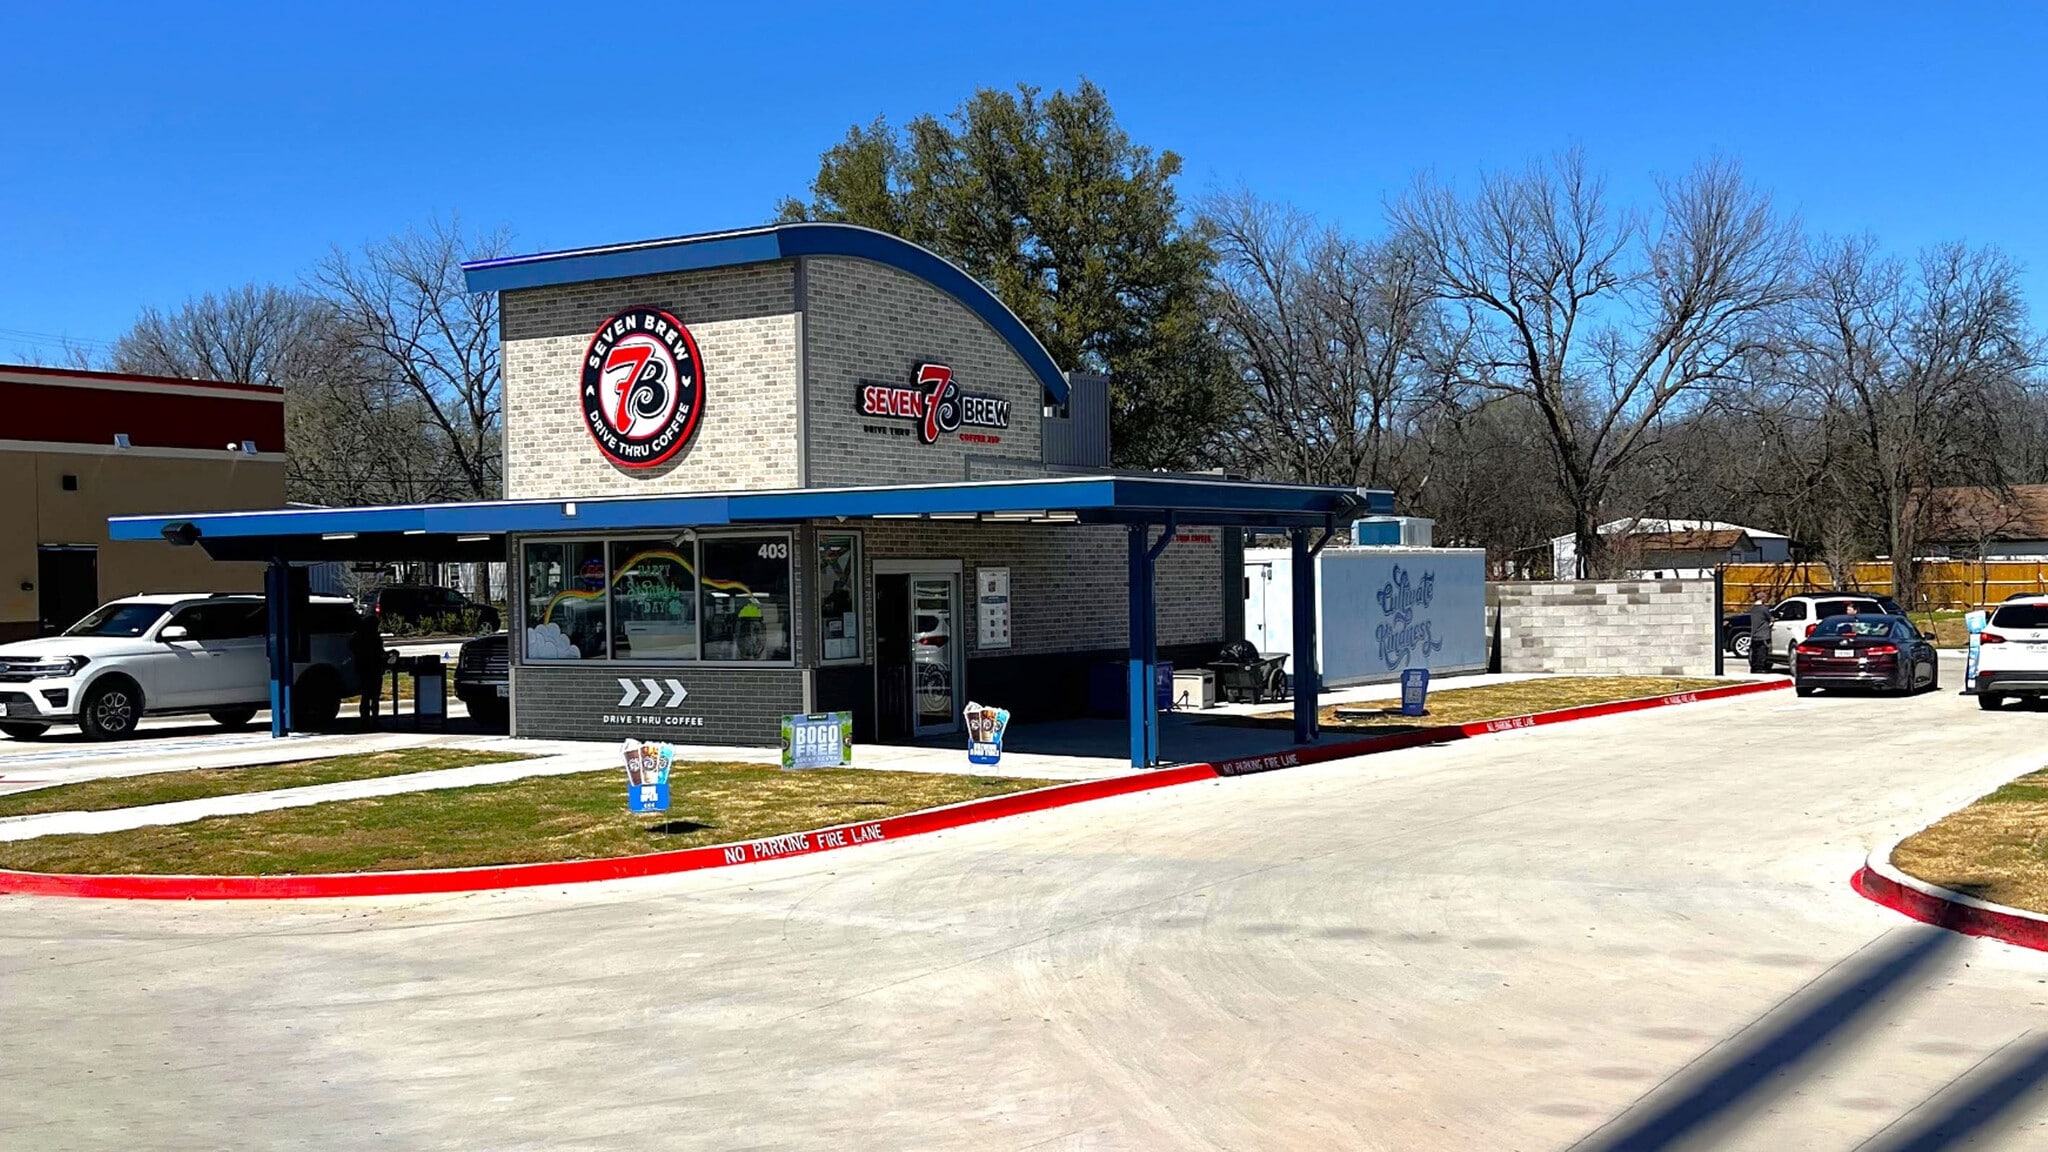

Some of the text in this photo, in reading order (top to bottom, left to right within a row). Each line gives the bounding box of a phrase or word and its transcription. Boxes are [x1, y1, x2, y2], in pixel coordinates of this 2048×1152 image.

[589, 315, 689, 369] SEVEN BREW
[864, 385, 923, 418] SEVEN
[962, 396, 1011, 427] BREW
[590, 402, 690, 457] DRIVE THRU COFFEE
[864, 425, 910, 436] DRIVE THRU
[758, 543, 787, 559] 403
[637, 564, 671, 577] HAPPY
[1376, 563, 1435, 618] Cultivate
[644, 601, 666, 613] DAY
[1375, 619, 1442, 670] Kindness
[603, 715, 704, 726] DRIVE THRU COFFEE
[796, 725, 839, 745] BOGO
[796, 742, 839, 757] FREE
[1223, 754, 1299, 775] NO PARKING FIRE LANE
[724, 824, 885, 864] NO PARKING FIRE LANE
